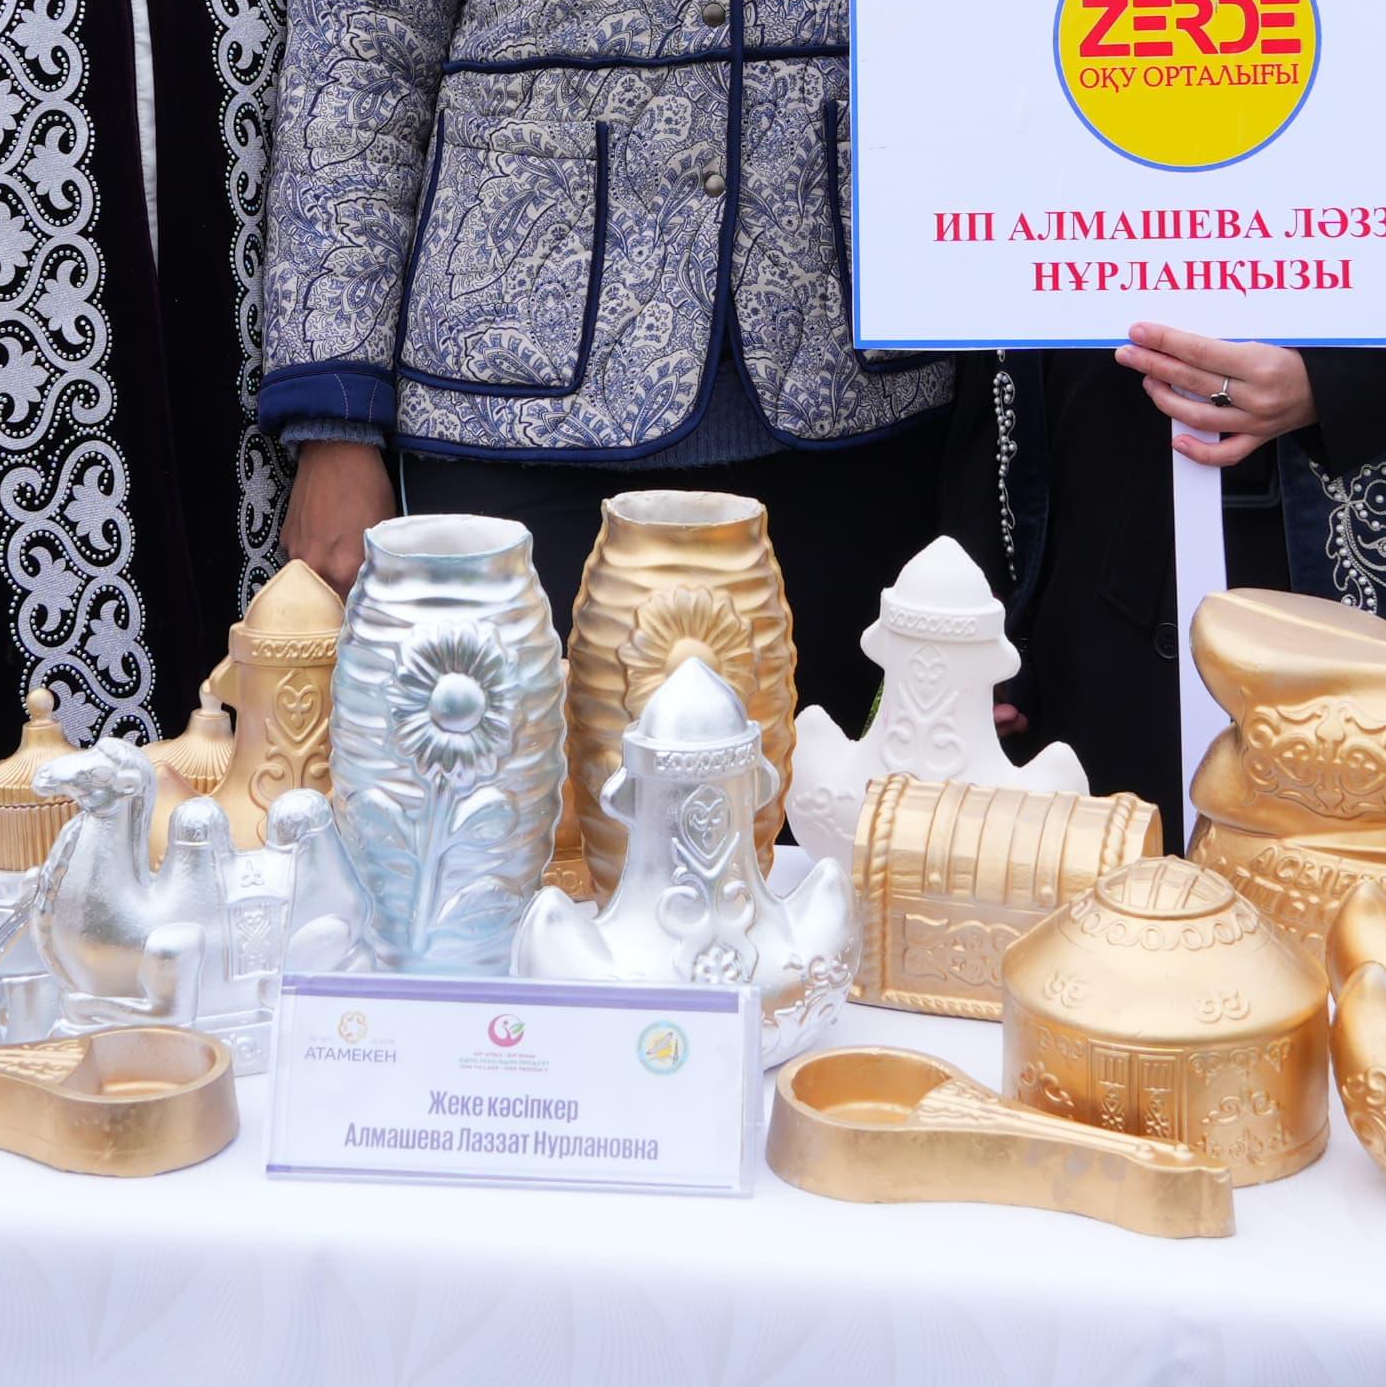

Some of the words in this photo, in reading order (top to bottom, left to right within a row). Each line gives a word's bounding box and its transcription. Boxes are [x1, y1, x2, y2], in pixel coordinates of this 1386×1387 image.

[1080, 66, 1136, 93] ОҚУ
[1143, 62, 1300, 88] ОРТАЛЫҒЫ
[934, 211, 995, 243] ИП
[1008, 208, 1272, 243] АЛМАШЕВА
[1032, 258, 1354, 297] НҰРЛАНҚЫЗЫ
[304, 1046, 396, 1062] АТАМЕКЕН
[428, 1090, 483, 1116] Жеке
[487, 1094, 579, 1124] кәсіпкер
[344, 1122, 453, 1152] Алмашева
[457, 1127, 530, 1155] Лаззат
[533, 1130, 659, 1161] Нурлановна
